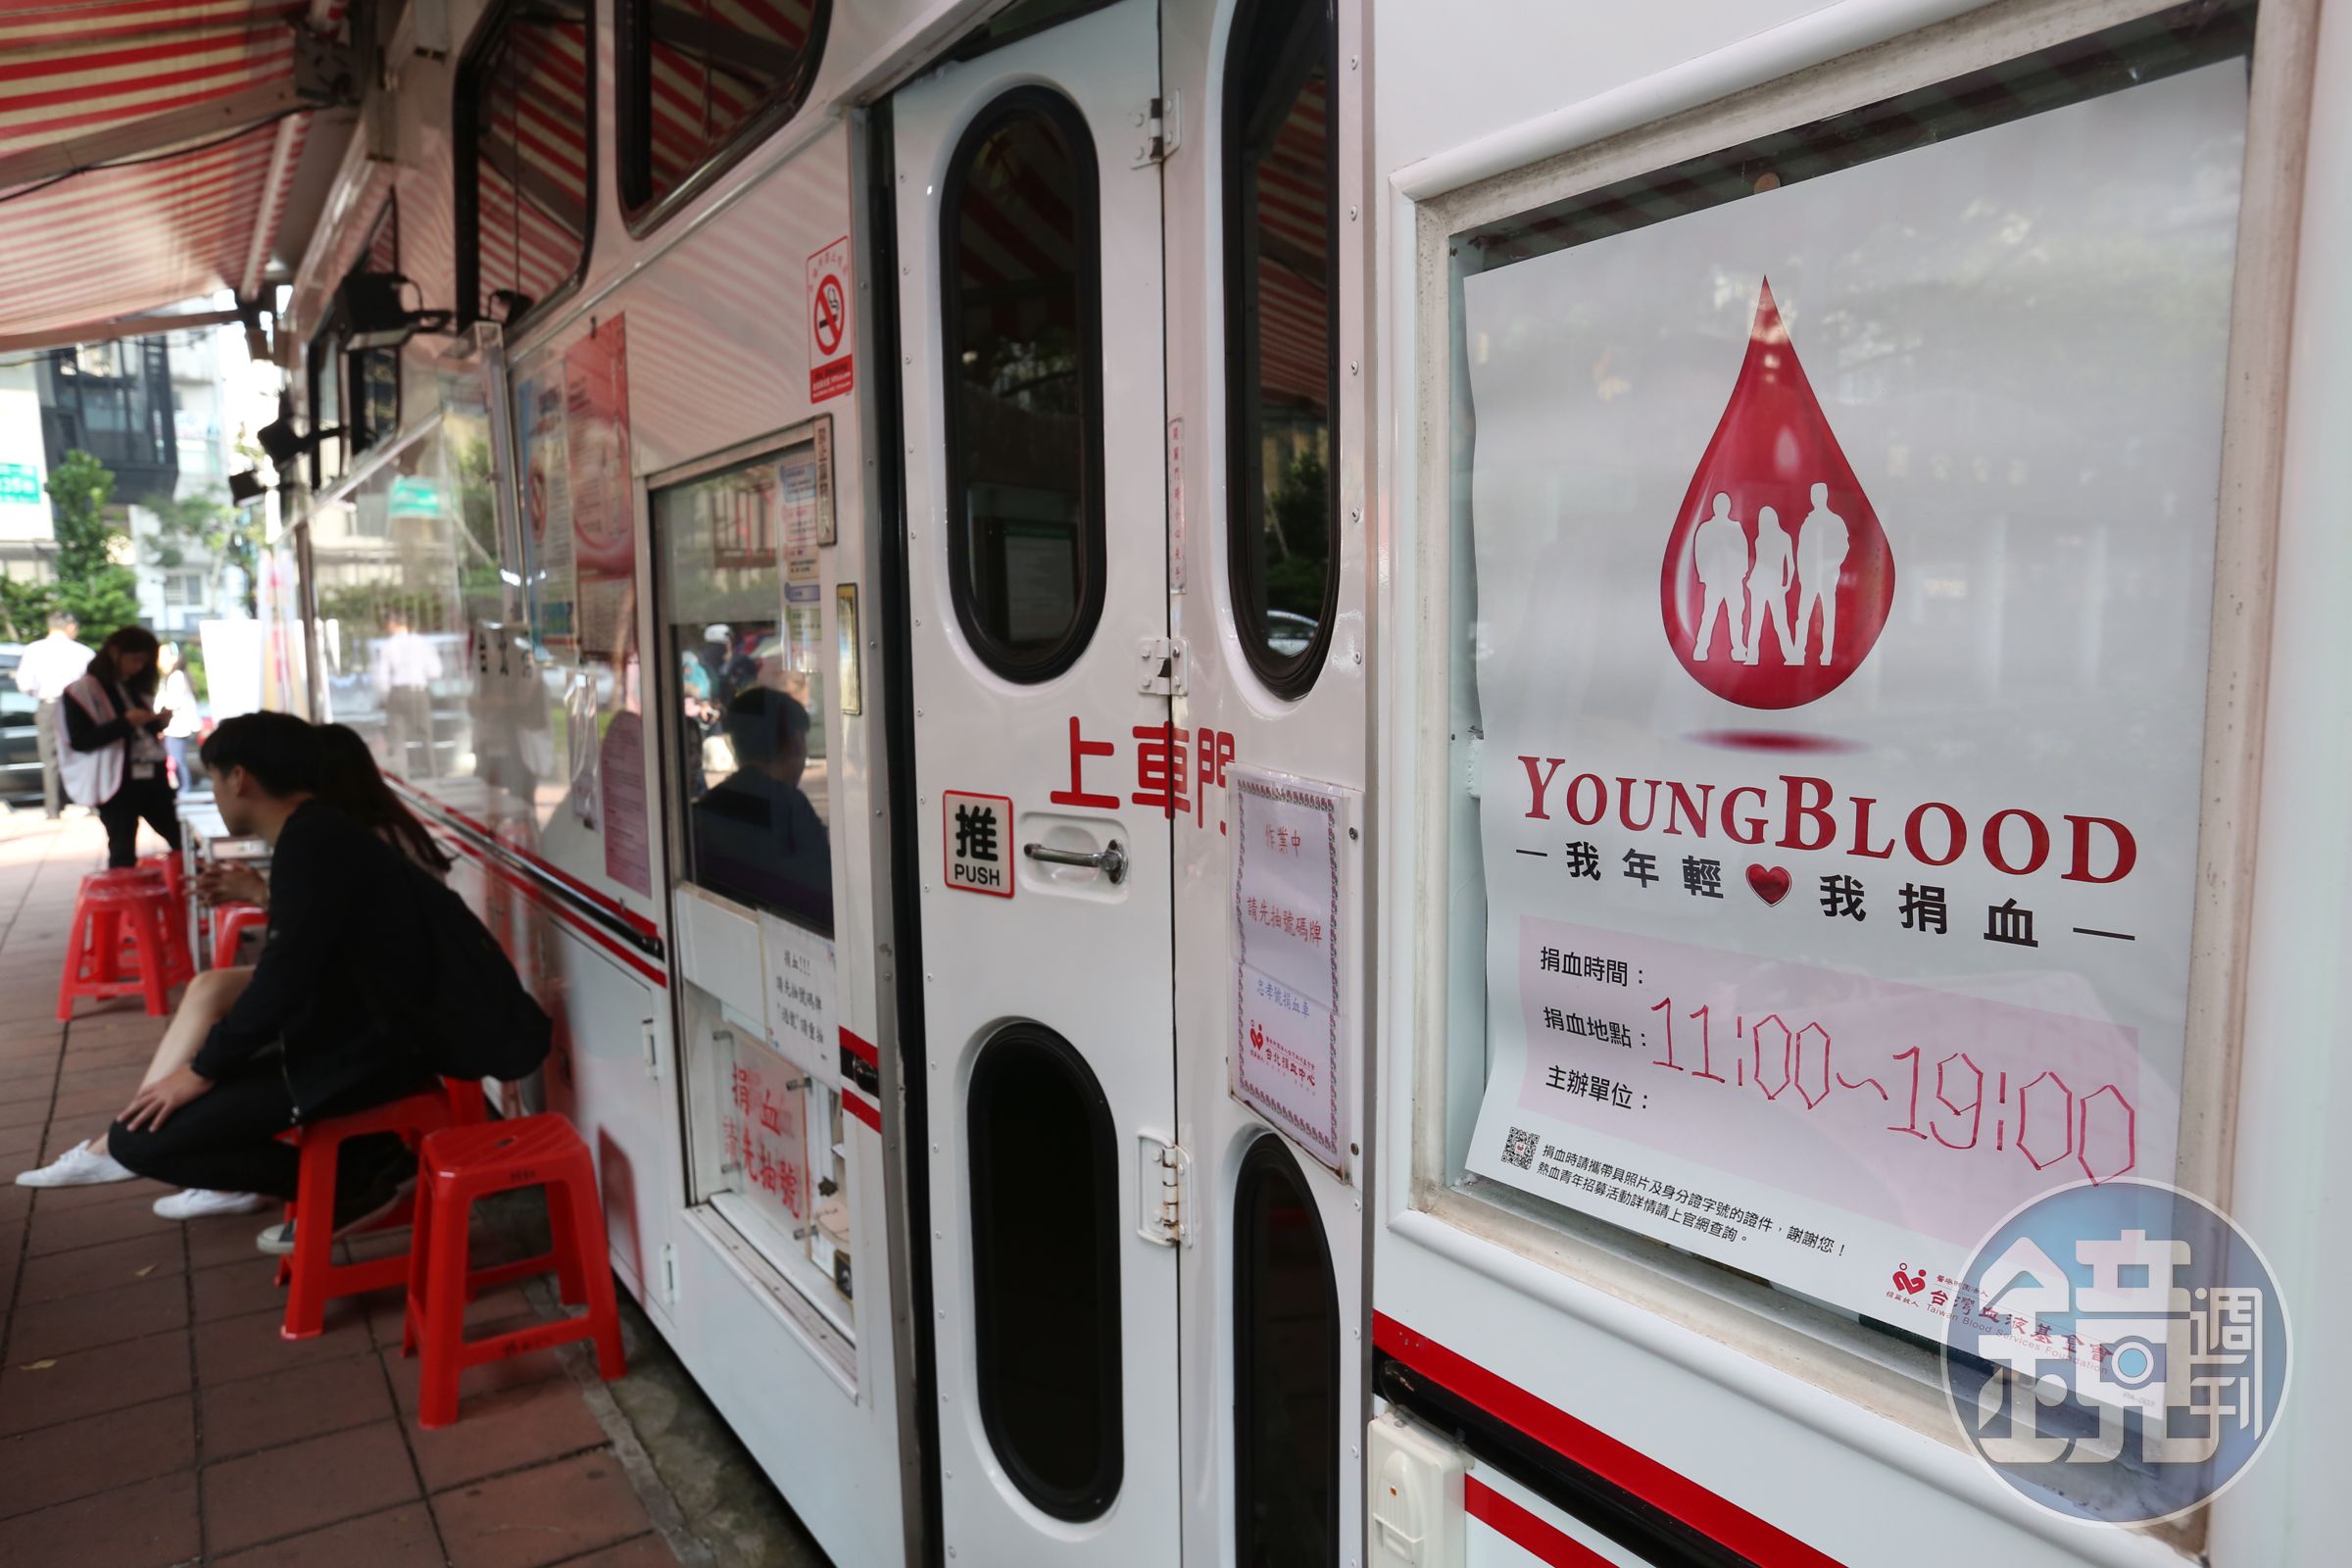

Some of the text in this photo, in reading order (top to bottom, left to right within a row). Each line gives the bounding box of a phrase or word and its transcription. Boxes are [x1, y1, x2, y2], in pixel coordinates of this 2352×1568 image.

[1050, 716, 1235, 836] 上車門
[956, 804, 999, 861] 推
[1265, 823, 1301, 858] 作業中
[955, 863, 1000, 887] PUSH
[1566, 840, 2039, 948] 我年輕 我捐血
[1247, 897, 1322, 948] 請先抽號碼牌
[1927, 1303, 2109, 1375] Taiwan Blood Services Foundation
